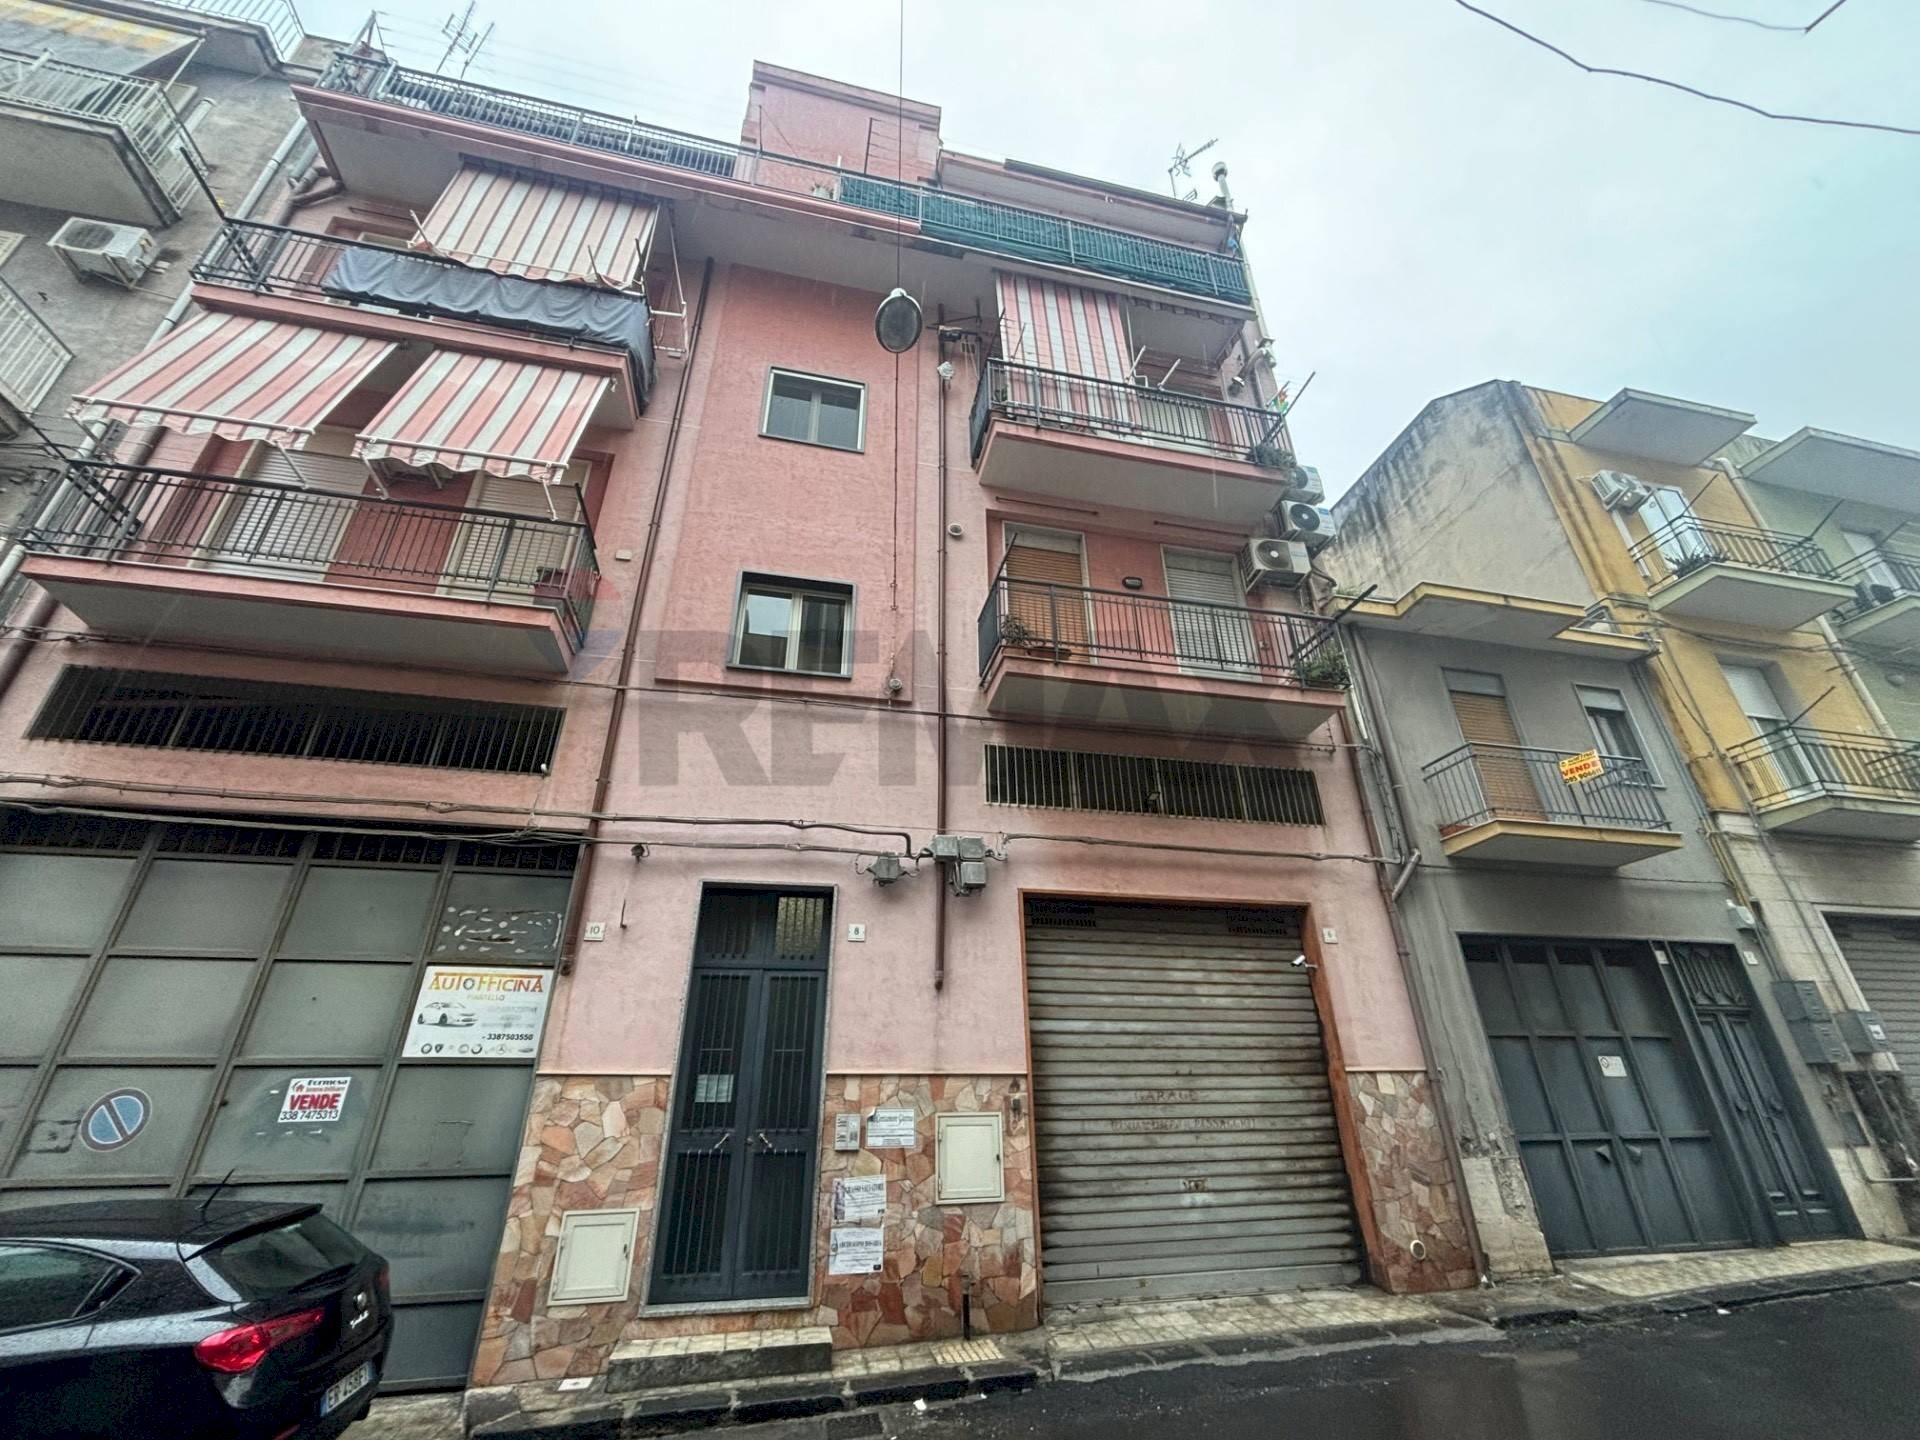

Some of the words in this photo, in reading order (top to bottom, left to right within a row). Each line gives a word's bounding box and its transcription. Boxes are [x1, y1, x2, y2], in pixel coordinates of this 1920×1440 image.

[589, 925, 601, 936] 10
[429, 971, 544, 993] AUTOFFICINA
[289, 1094, 341, 1110] VENDE
[280, 1111, 298, 1120] 338
[300, 1110, 339, 1119] 7475313
